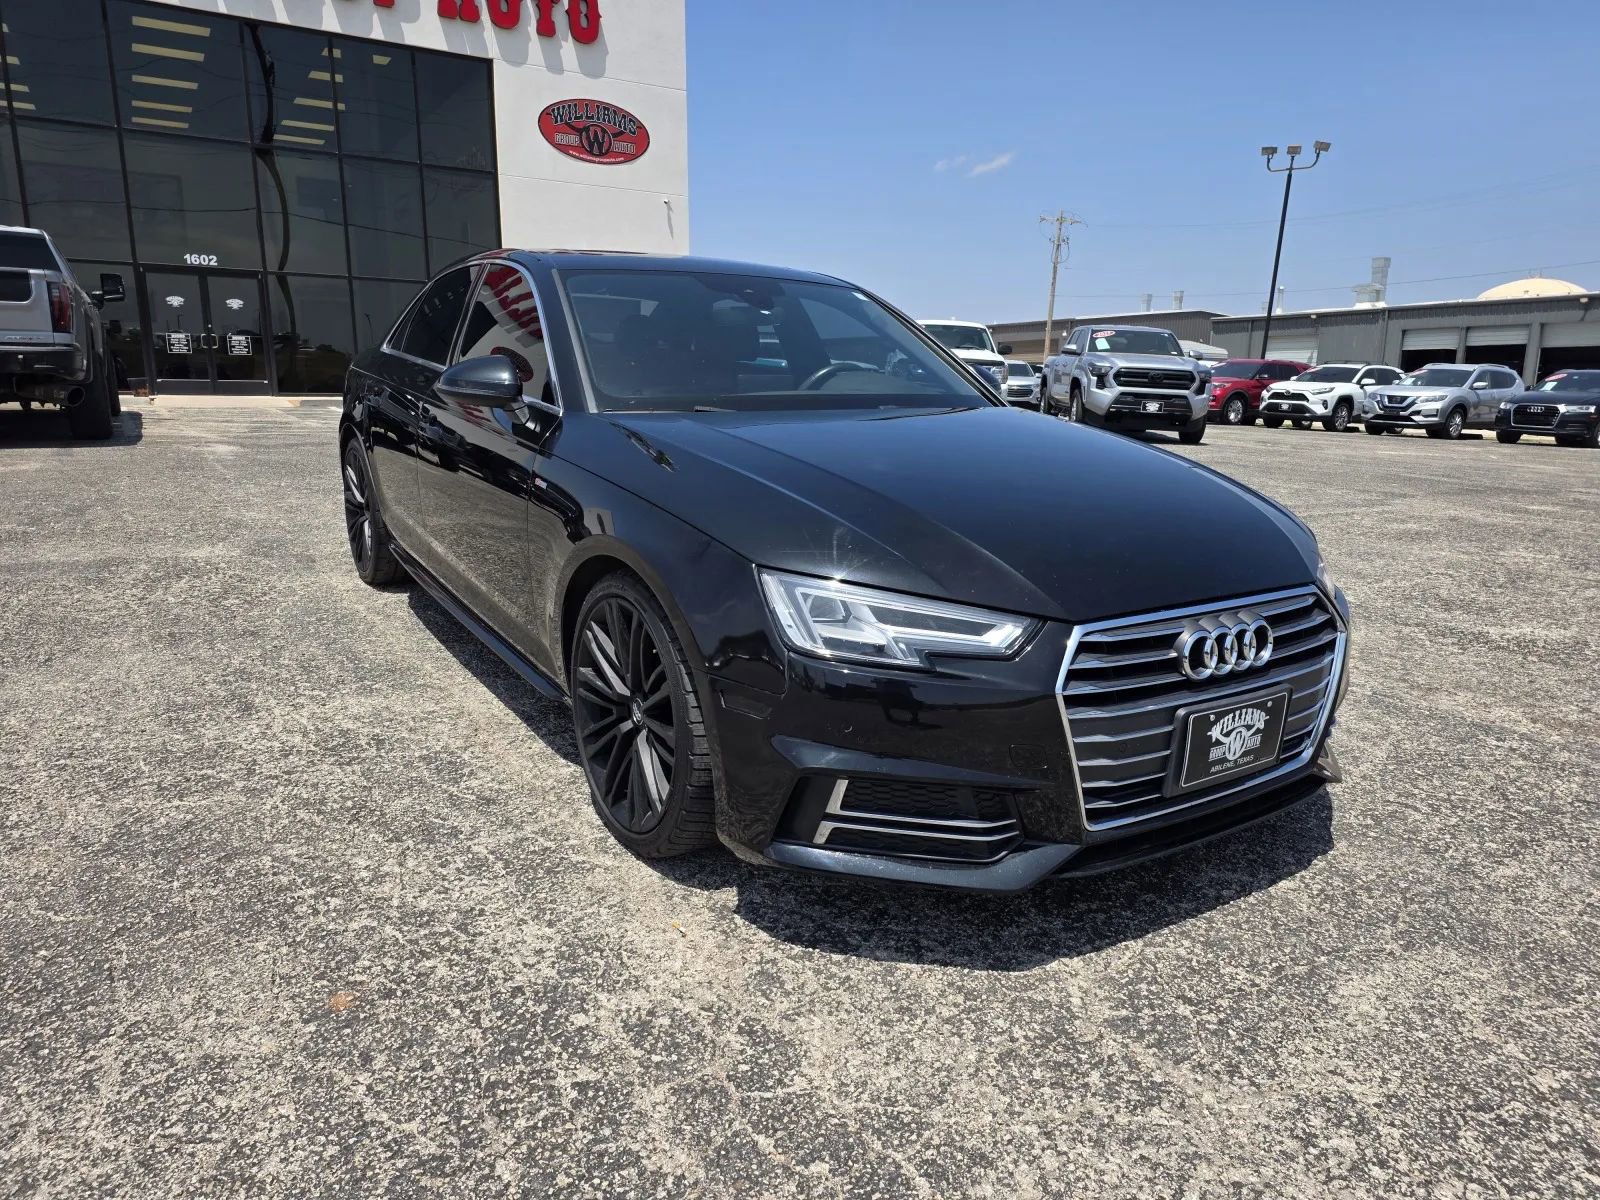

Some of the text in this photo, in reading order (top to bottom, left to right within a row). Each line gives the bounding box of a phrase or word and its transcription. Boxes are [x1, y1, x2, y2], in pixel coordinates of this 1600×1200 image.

[550, 102, 637, 136] WILLIAMS
[555, 132, 580, 145] GROUP
[610, 142, 635, 154] AUTO
[184, 253, 218, 266] 1602
[1211, 708, 1266, 742] WILLIAMS
[1209, 746, 1226, 760] GROUP
[1244, 735, 1261, 750] AUTO
[1236, 755, 1254, 766] TEXAS
